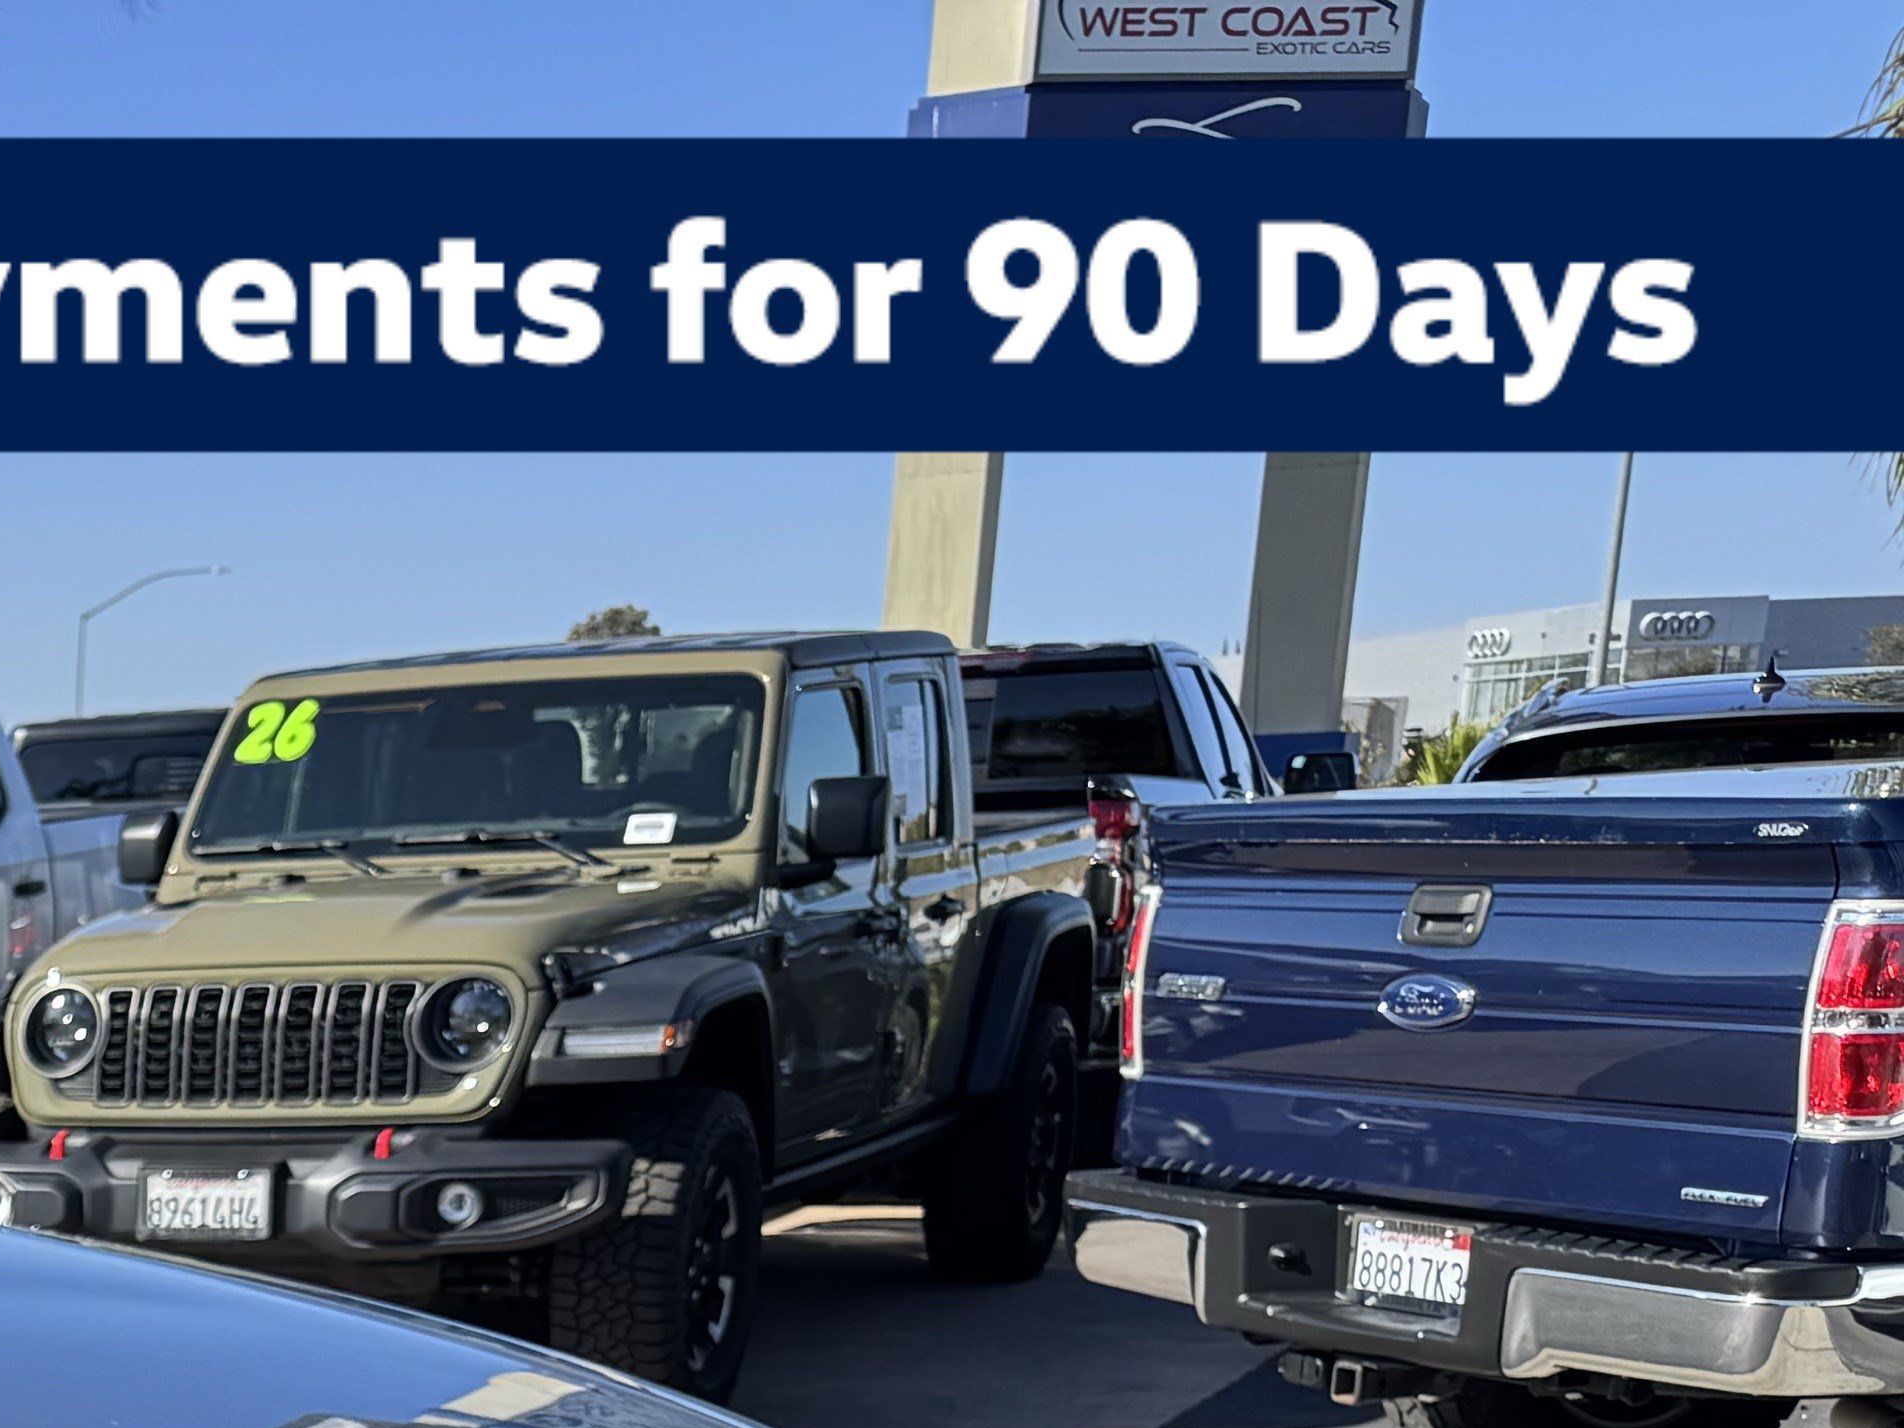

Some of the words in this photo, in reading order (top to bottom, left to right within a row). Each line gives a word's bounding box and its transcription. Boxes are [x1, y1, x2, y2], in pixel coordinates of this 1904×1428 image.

[1078, 7, 1208, 37] WEST
[1220, 6, 1380, 37] COAST
[1256, 41, 1327, 55] EXOTIC
[1333, 41, 1392, 55] CARS
[233, 699, 320, 765] 26
[1359, 1249, 1465, 1303] 88817K3
